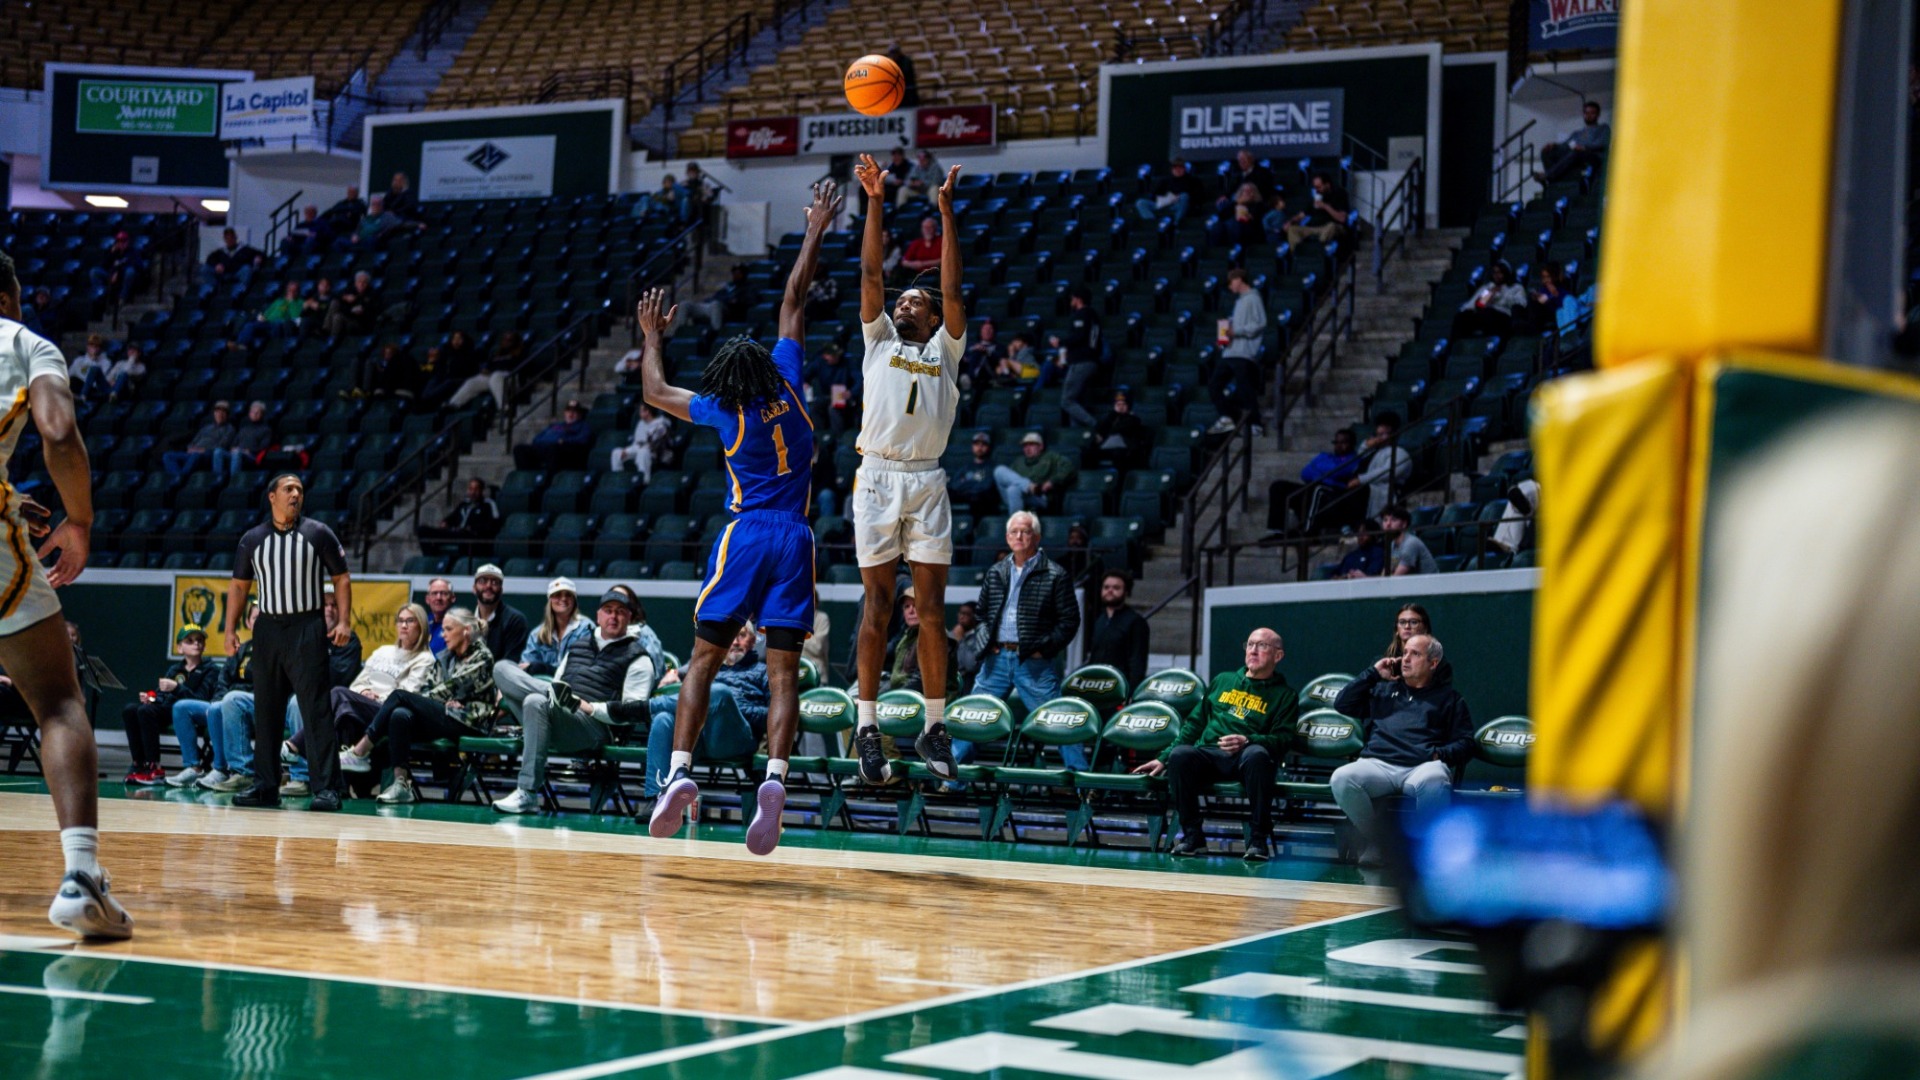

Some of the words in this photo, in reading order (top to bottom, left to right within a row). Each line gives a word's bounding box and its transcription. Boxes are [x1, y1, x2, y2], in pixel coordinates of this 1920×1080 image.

[86, 86, 203, 105] COURTYARD
[226, 94, 246, 112] La
[249, 88, 309, 113] Capitol
[808, 117, 907, 138] CONCESSIONS
[1181, 102, 1331, 135] DUFRENE
[1180, 134, 1246, 149] BUILDING
[1251, 132, 1330, 146] MATERIALS
[905, 380, 919, 415] 1
[772, 424, 792, 476] 1
[1218, 690, 1268, 715] BASKETBALL
[1311, 685, 1340, 699] Lio
